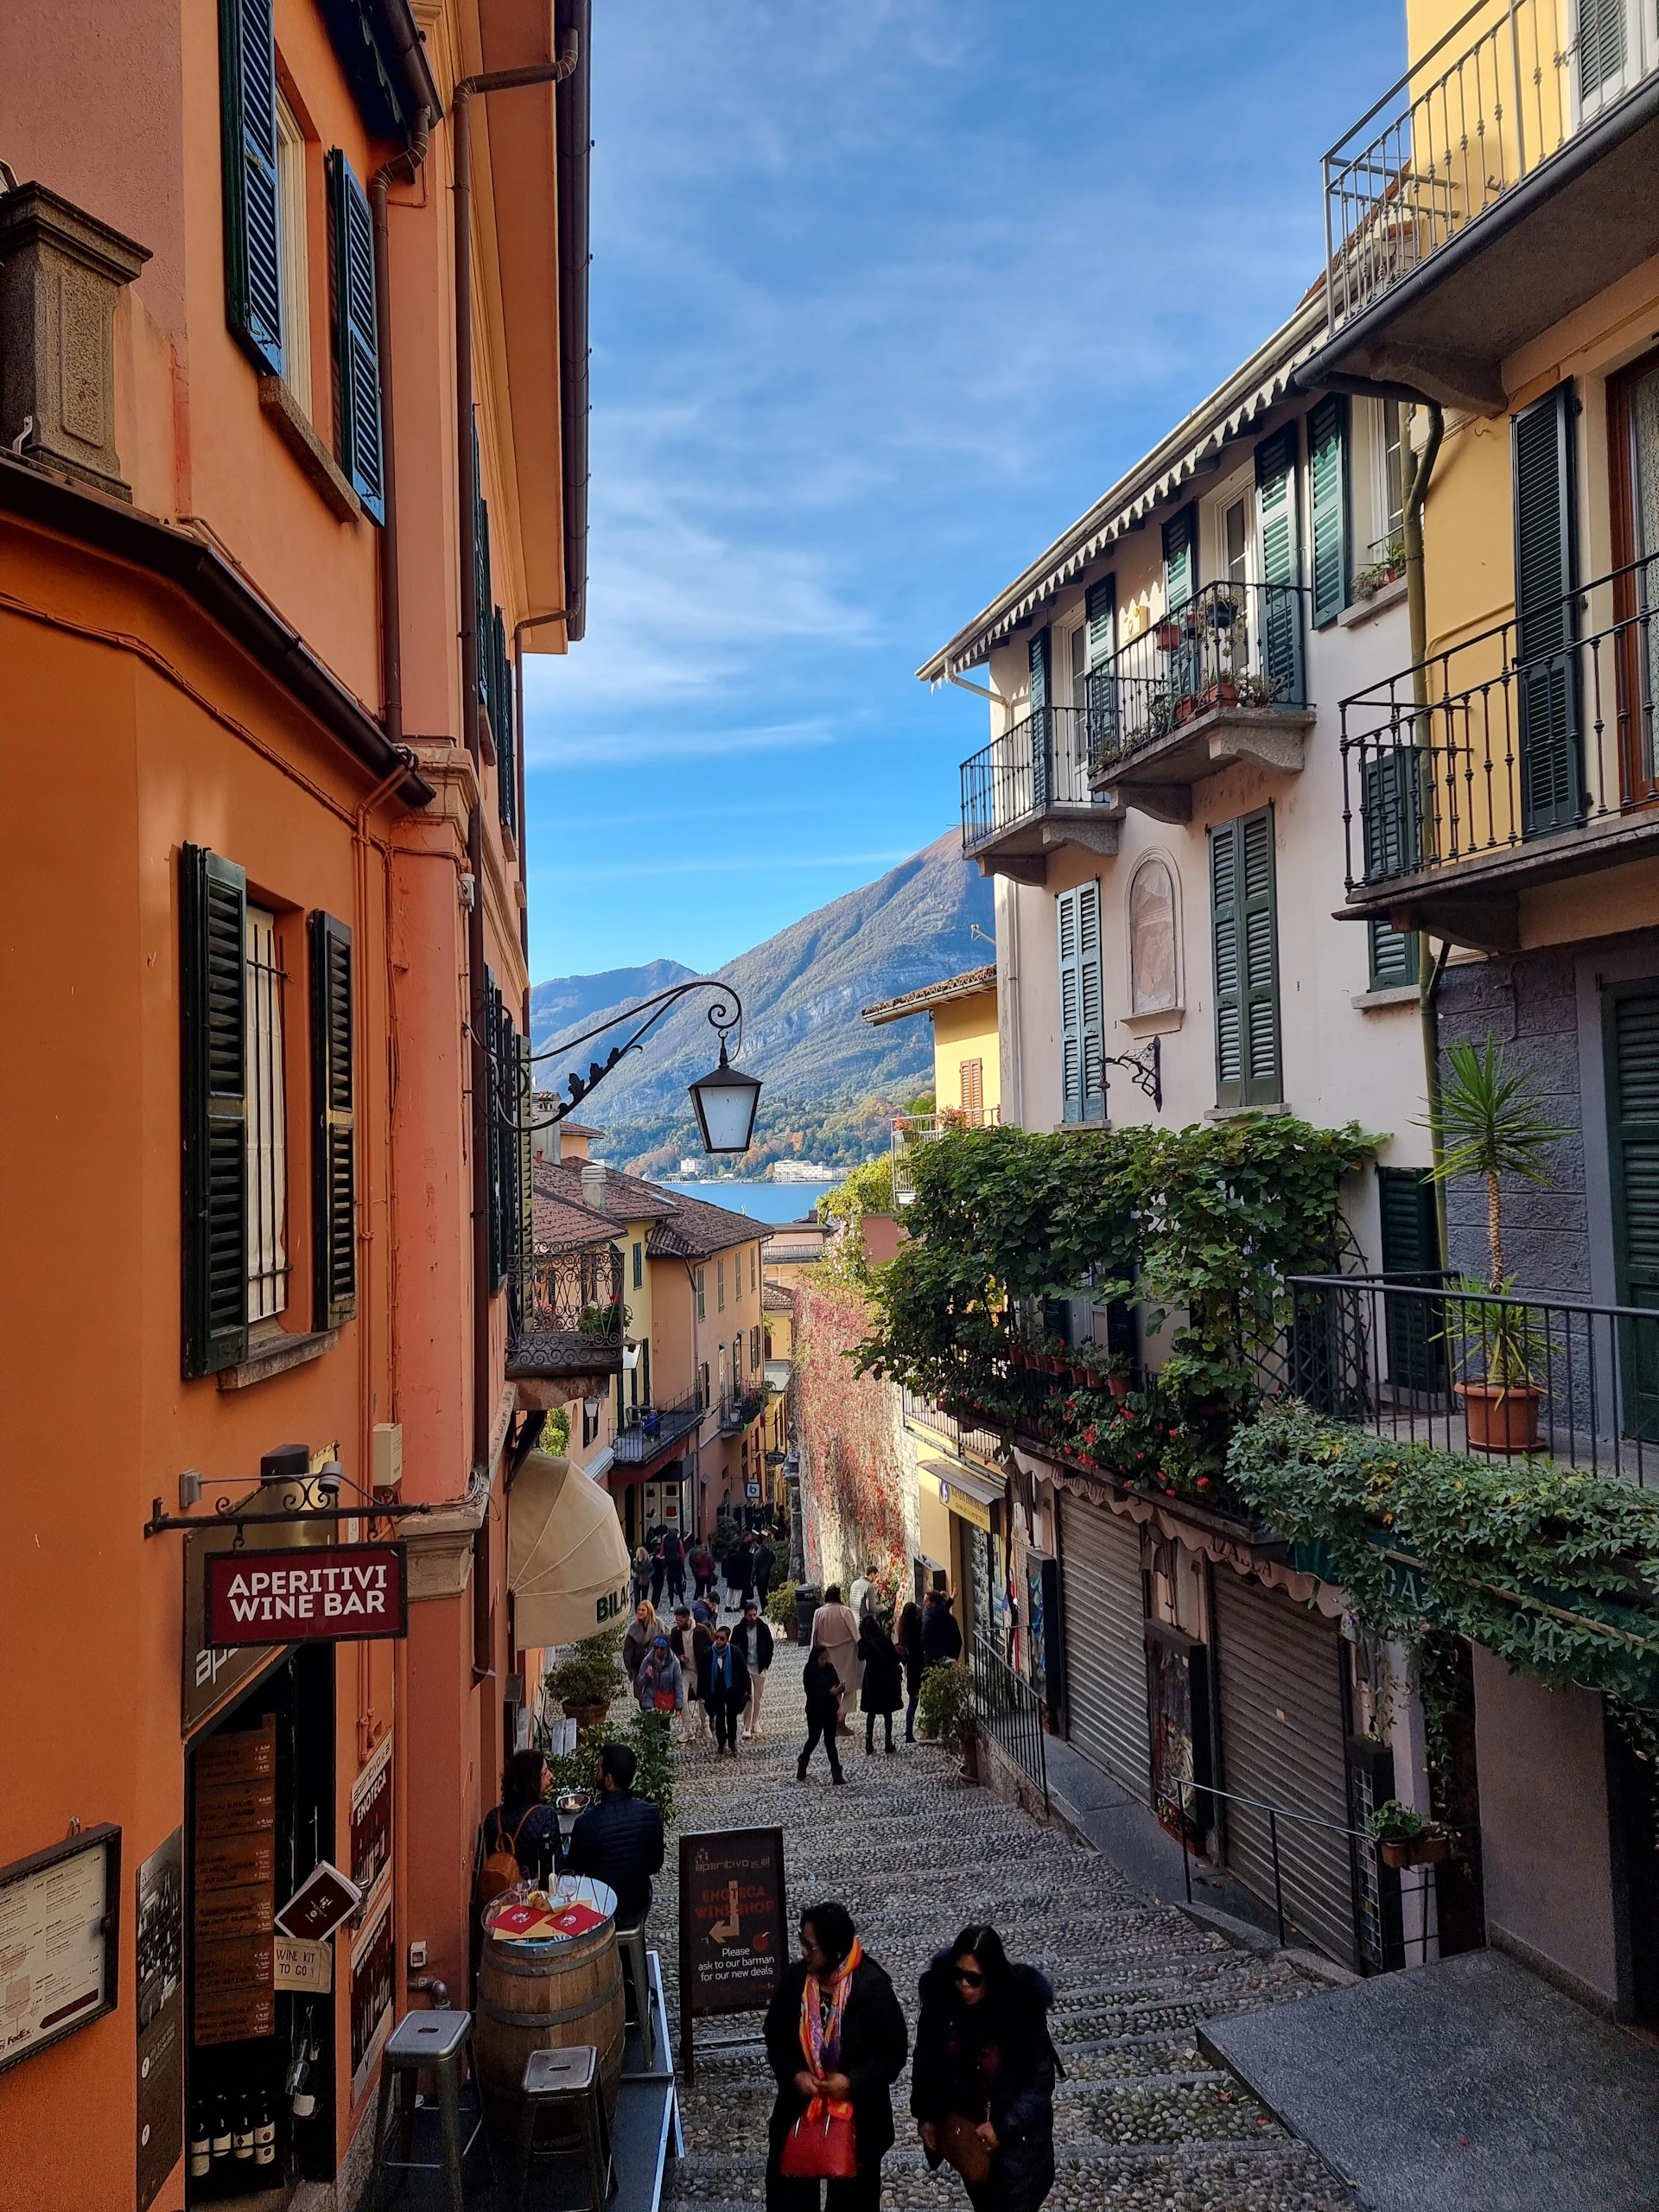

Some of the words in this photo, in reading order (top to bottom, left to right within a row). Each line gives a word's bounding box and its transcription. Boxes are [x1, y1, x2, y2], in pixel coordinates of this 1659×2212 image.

[227, 1565, 387, 1598] APERITIVI
[229, 1595, 314, 1623] WINE
[324, 1591, 386, 1617] BAR
[357, 1769, 387, 1827] ENOTECA
[696, 1858, 749, 1873] aperitivo
[760, 1856, 770, 1867] al
[702, 1885, 766, 1904] ENOTECA
[276, 1948, 298, 1961] WINE
[303, 1951, 316, 1964] KIT
[721, 1947, 750, 1958] Please
[279, 1963, 291, 1974] TO
[295, 1965, 308, 1976] GO
[698, 1961, 713, 1971] ask
[715, 1960, 724, 1970] to
[726, 1959, 741, 1968] our
[741, 1955, 775, 1967] barman
[701, 1971, 713, 1982] for
[715, 1971, 729, 1980] our
[731, 1969, 749, 1979] new
[751, 1966, 773, 1977] deals
[7, 2028, 31, 2045] FedEx
